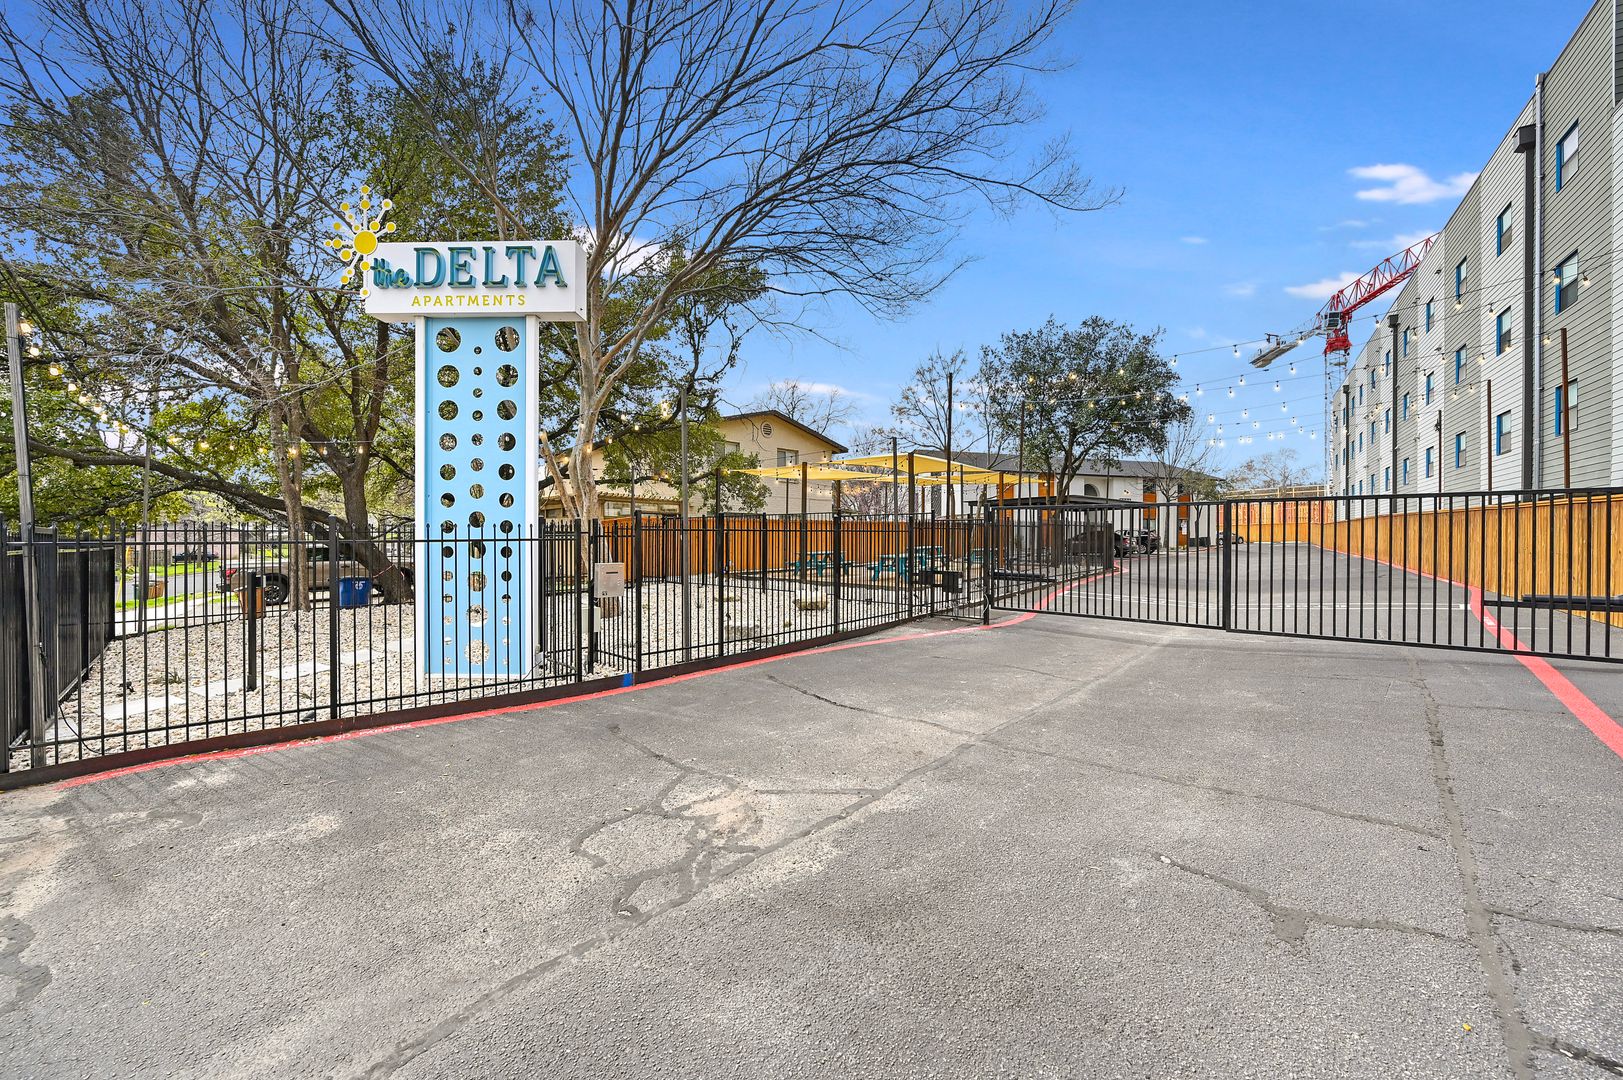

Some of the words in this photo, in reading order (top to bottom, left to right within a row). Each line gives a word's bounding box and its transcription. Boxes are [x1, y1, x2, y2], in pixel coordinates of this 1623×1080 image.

[370, 257, 413, 289] the
[413, 245, 568, 289] DELTA
[411, 294, 526, 307] APARTMENTS
